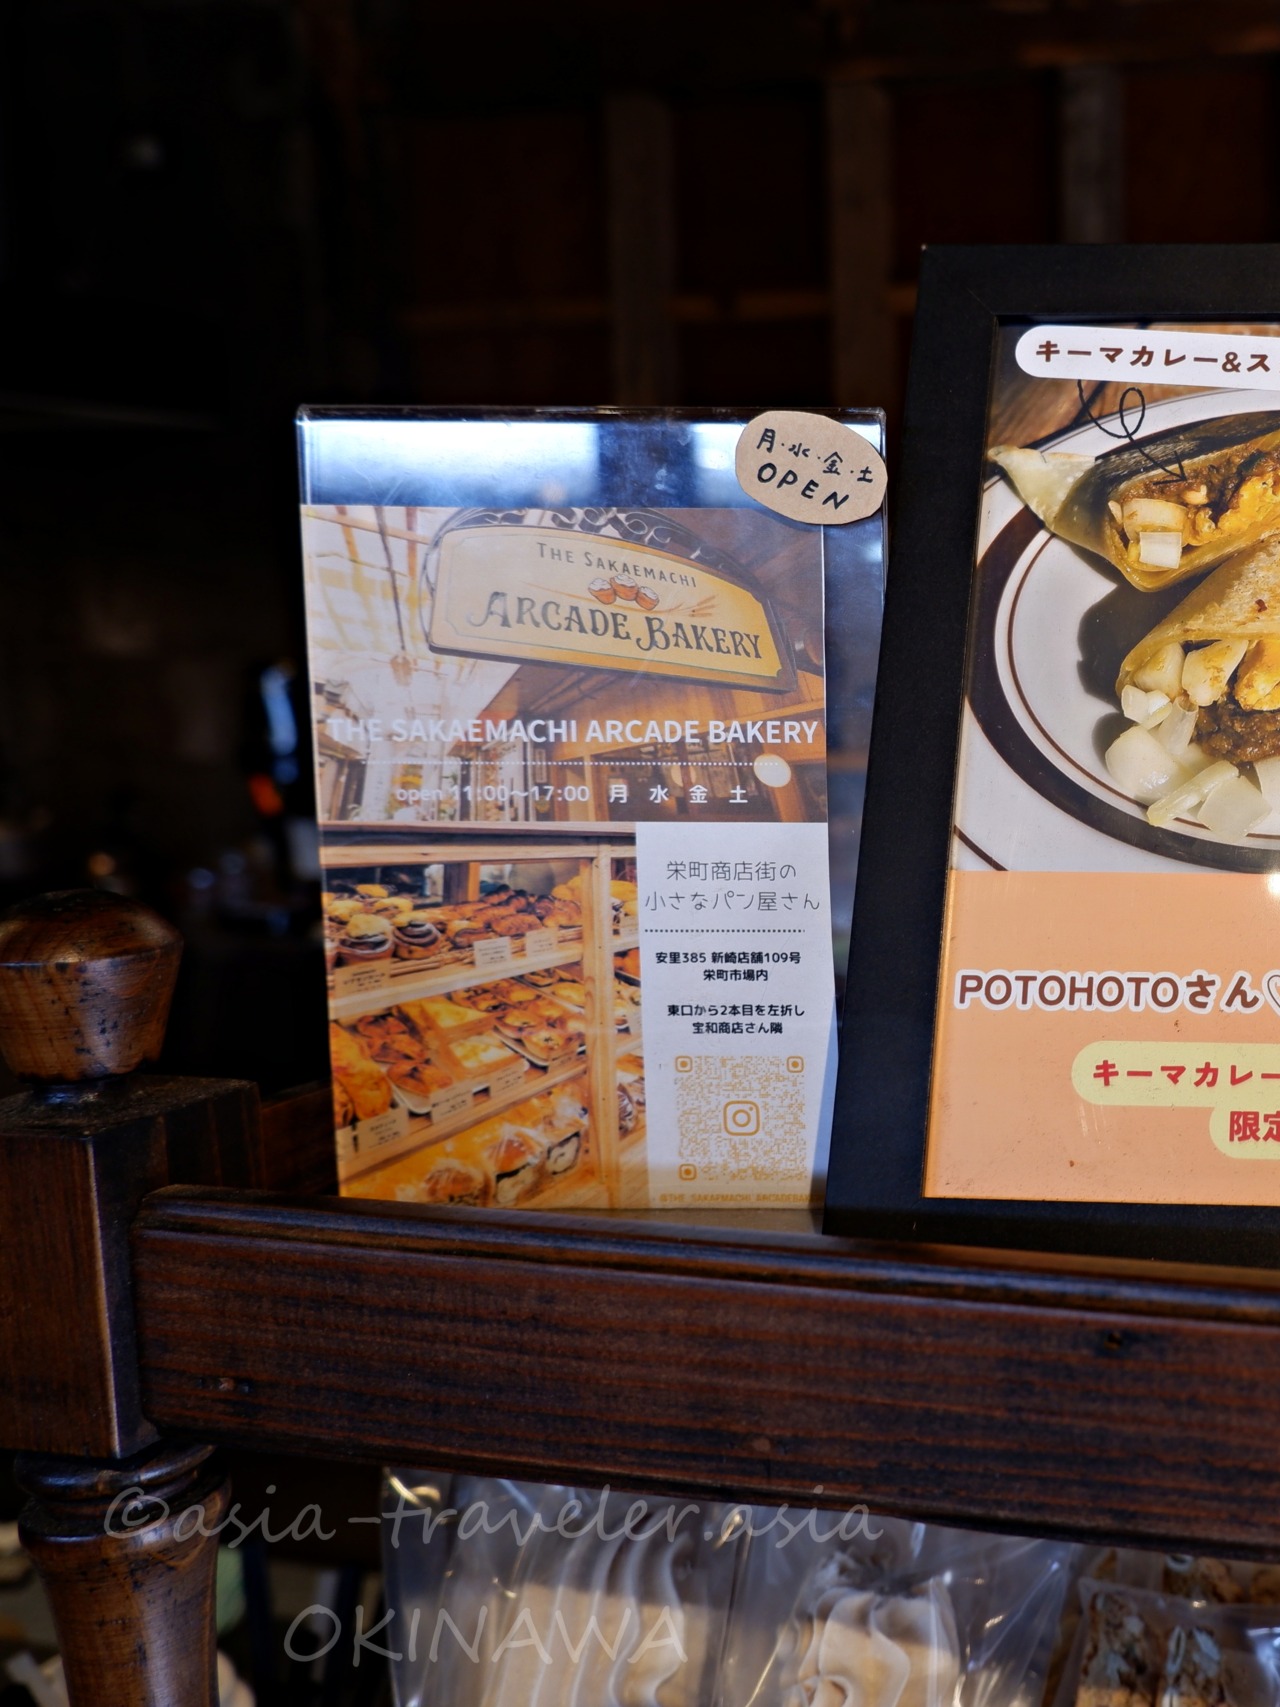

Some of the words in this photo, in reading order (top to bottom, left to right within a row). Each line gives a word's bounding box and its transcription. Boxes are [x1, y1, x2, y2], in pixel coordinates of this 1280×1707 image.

[757, 463, 849, 509] OPEN
[536, 542, 575, 564] THE
[584, 551, 698, 588] SAKAEMACHI
[466, 591, 633, 640] ARCADE
[636, 616, 762, 659] BAKERY
[327, 719, 383, 742] THE
[393, 719, 577, 743] SAKAEMACHI
[586, 720, 699, 743] ARCADE
[709, 721, 818, 744] BAKERY
[396, 787, 442, 805] open
[609, 785, 627, 803] 月
[650, 785, 670, 803] 水
[689, 785, 709, 803] 金
[729, 786, 748, 803] 土
[667, 861, 796, 881] 栄町商店街の
[645, 890, 820, 911] 小さなパン屋さん
[656, 952, 706, 964] 安里385
[711, 952, 801, 964] 新崎店舗109号
[703, 969, 768, 981] 栄町市場内
[667, 1004, 805, 1016] 東口から2本目を左折し
[692, 1022, 783, 1034] 宝和商店さん隣
